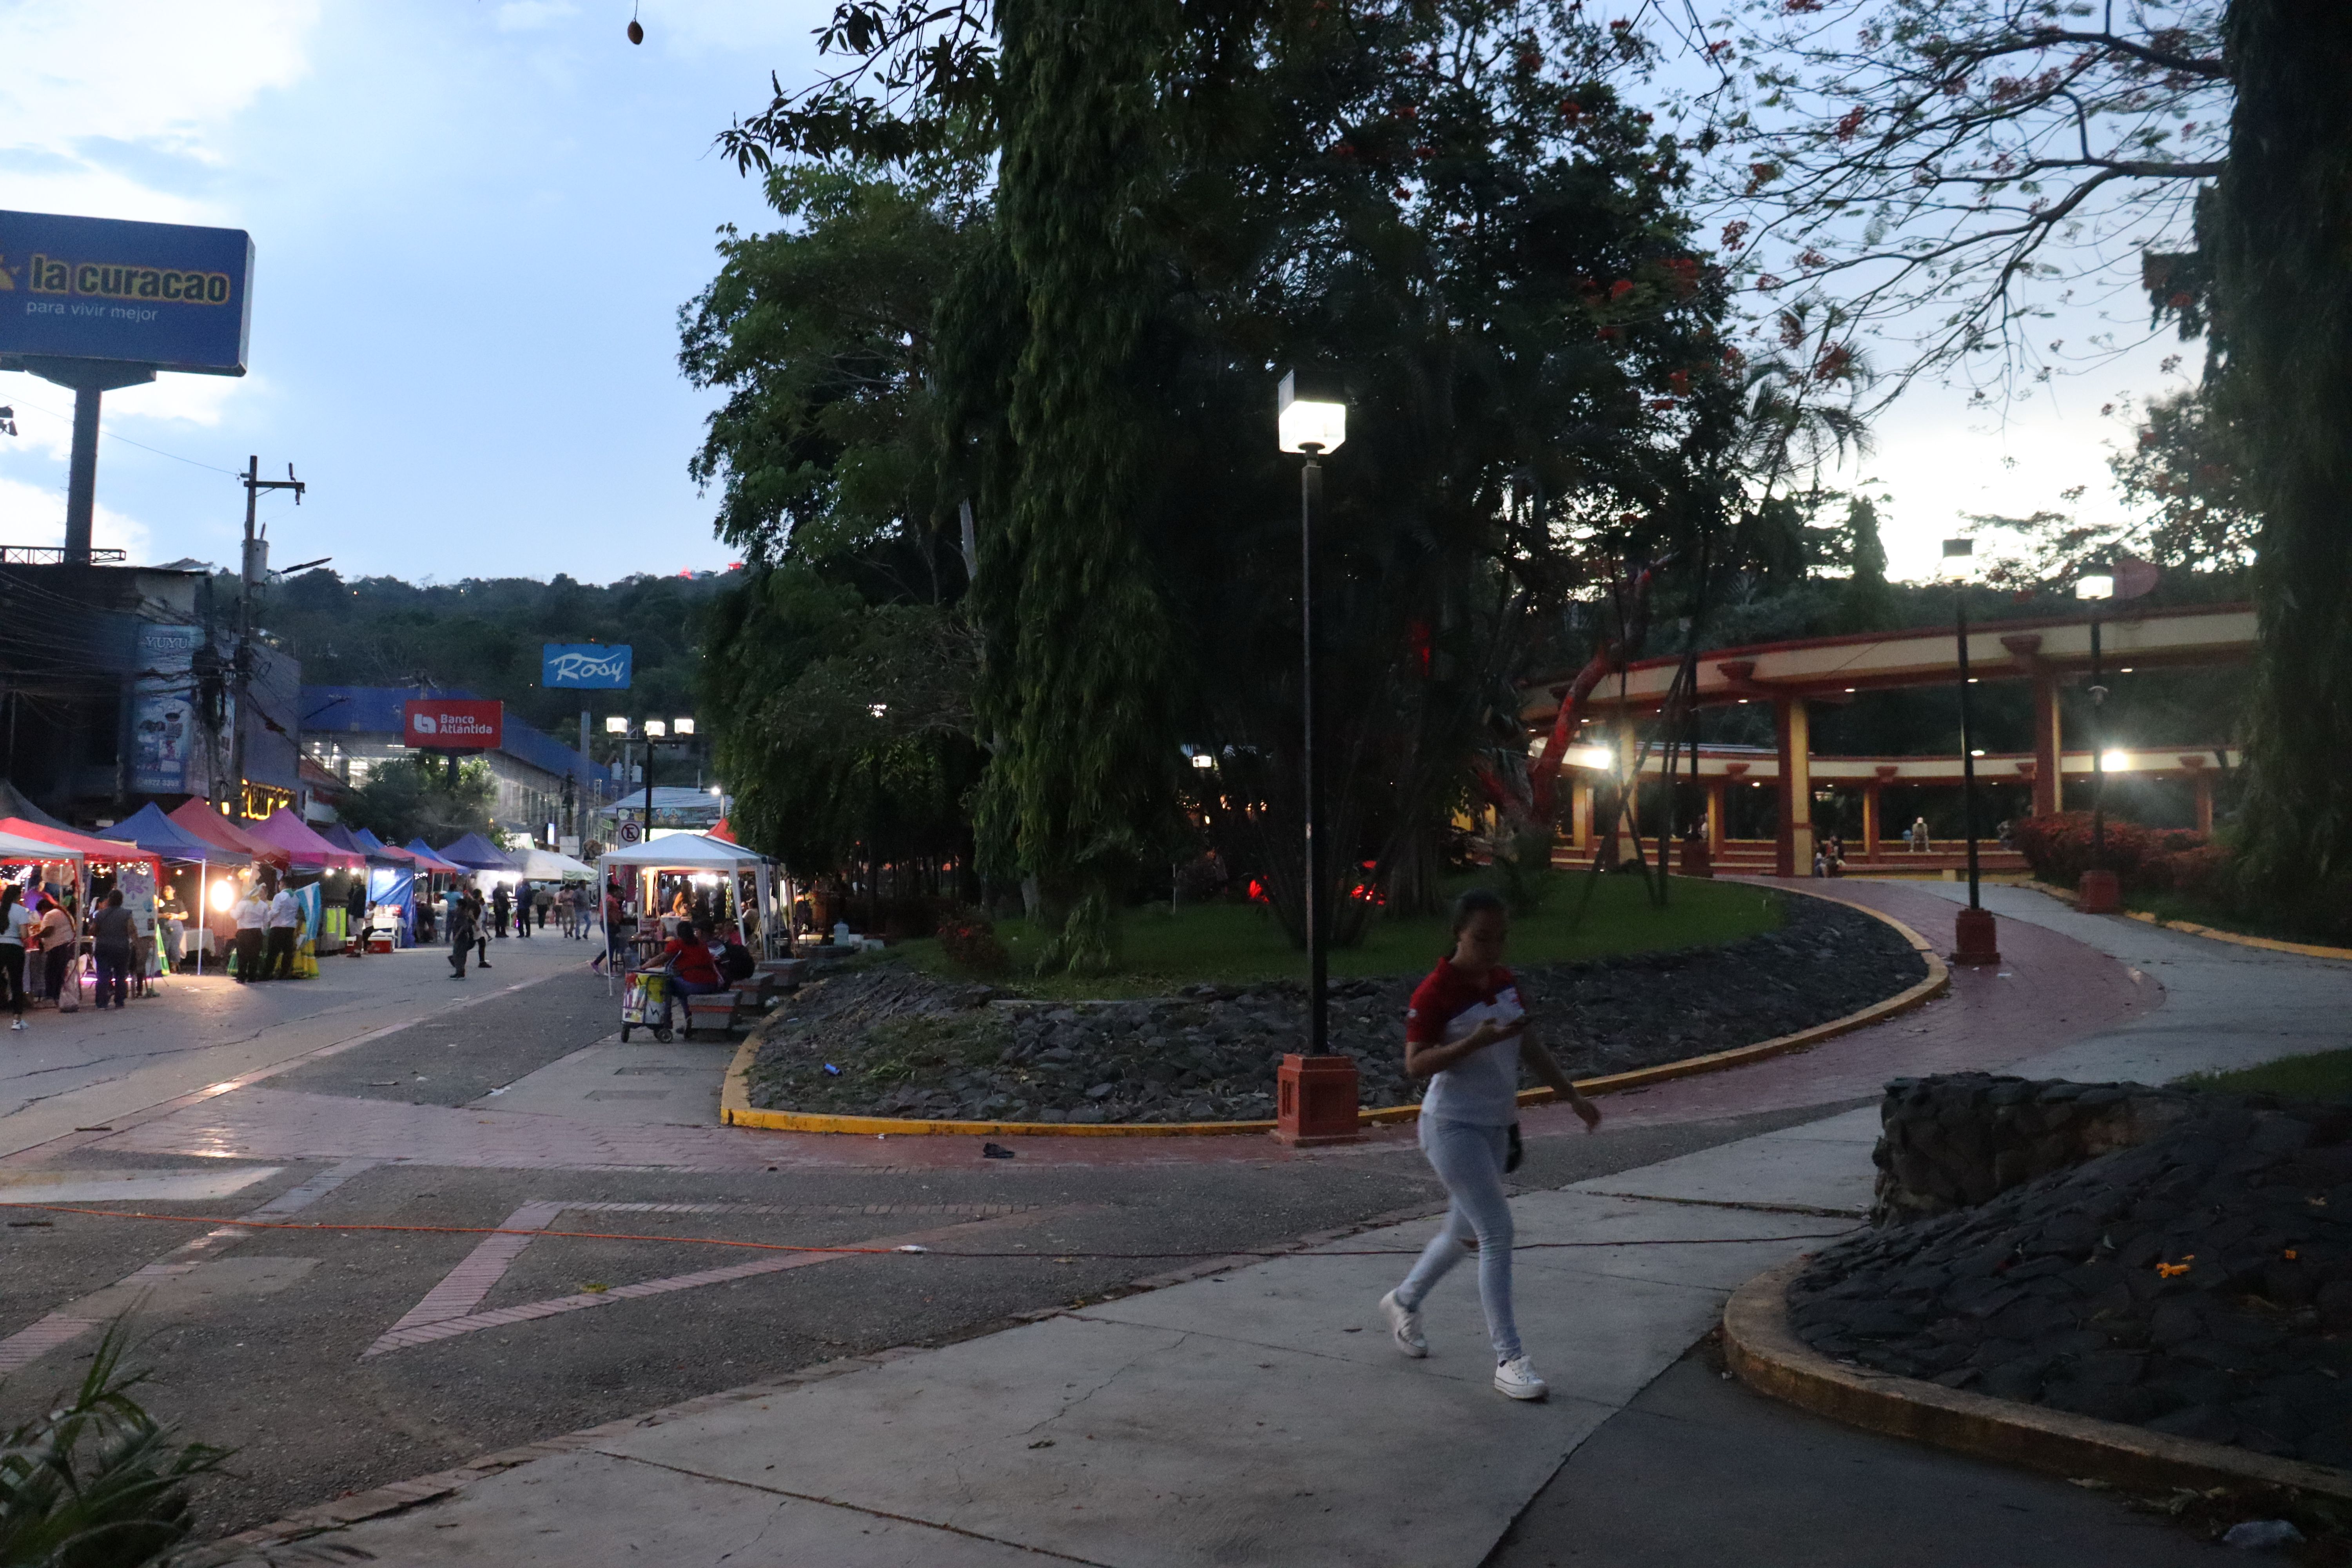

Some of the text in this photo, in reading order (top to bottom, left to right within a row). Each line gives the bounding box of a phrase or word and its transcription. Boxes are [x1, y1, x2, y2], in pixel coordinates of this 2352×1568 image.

[30, 254, 230, 304] la curacao
[27, 301, 158, 322] para vivir mejor
[145, 636, 188, 649] YUYU
[548, 653, 624, 682] Rosy
[440, 714, 474, 724] Banco
[440, 723, 492, 735] Atlántida
